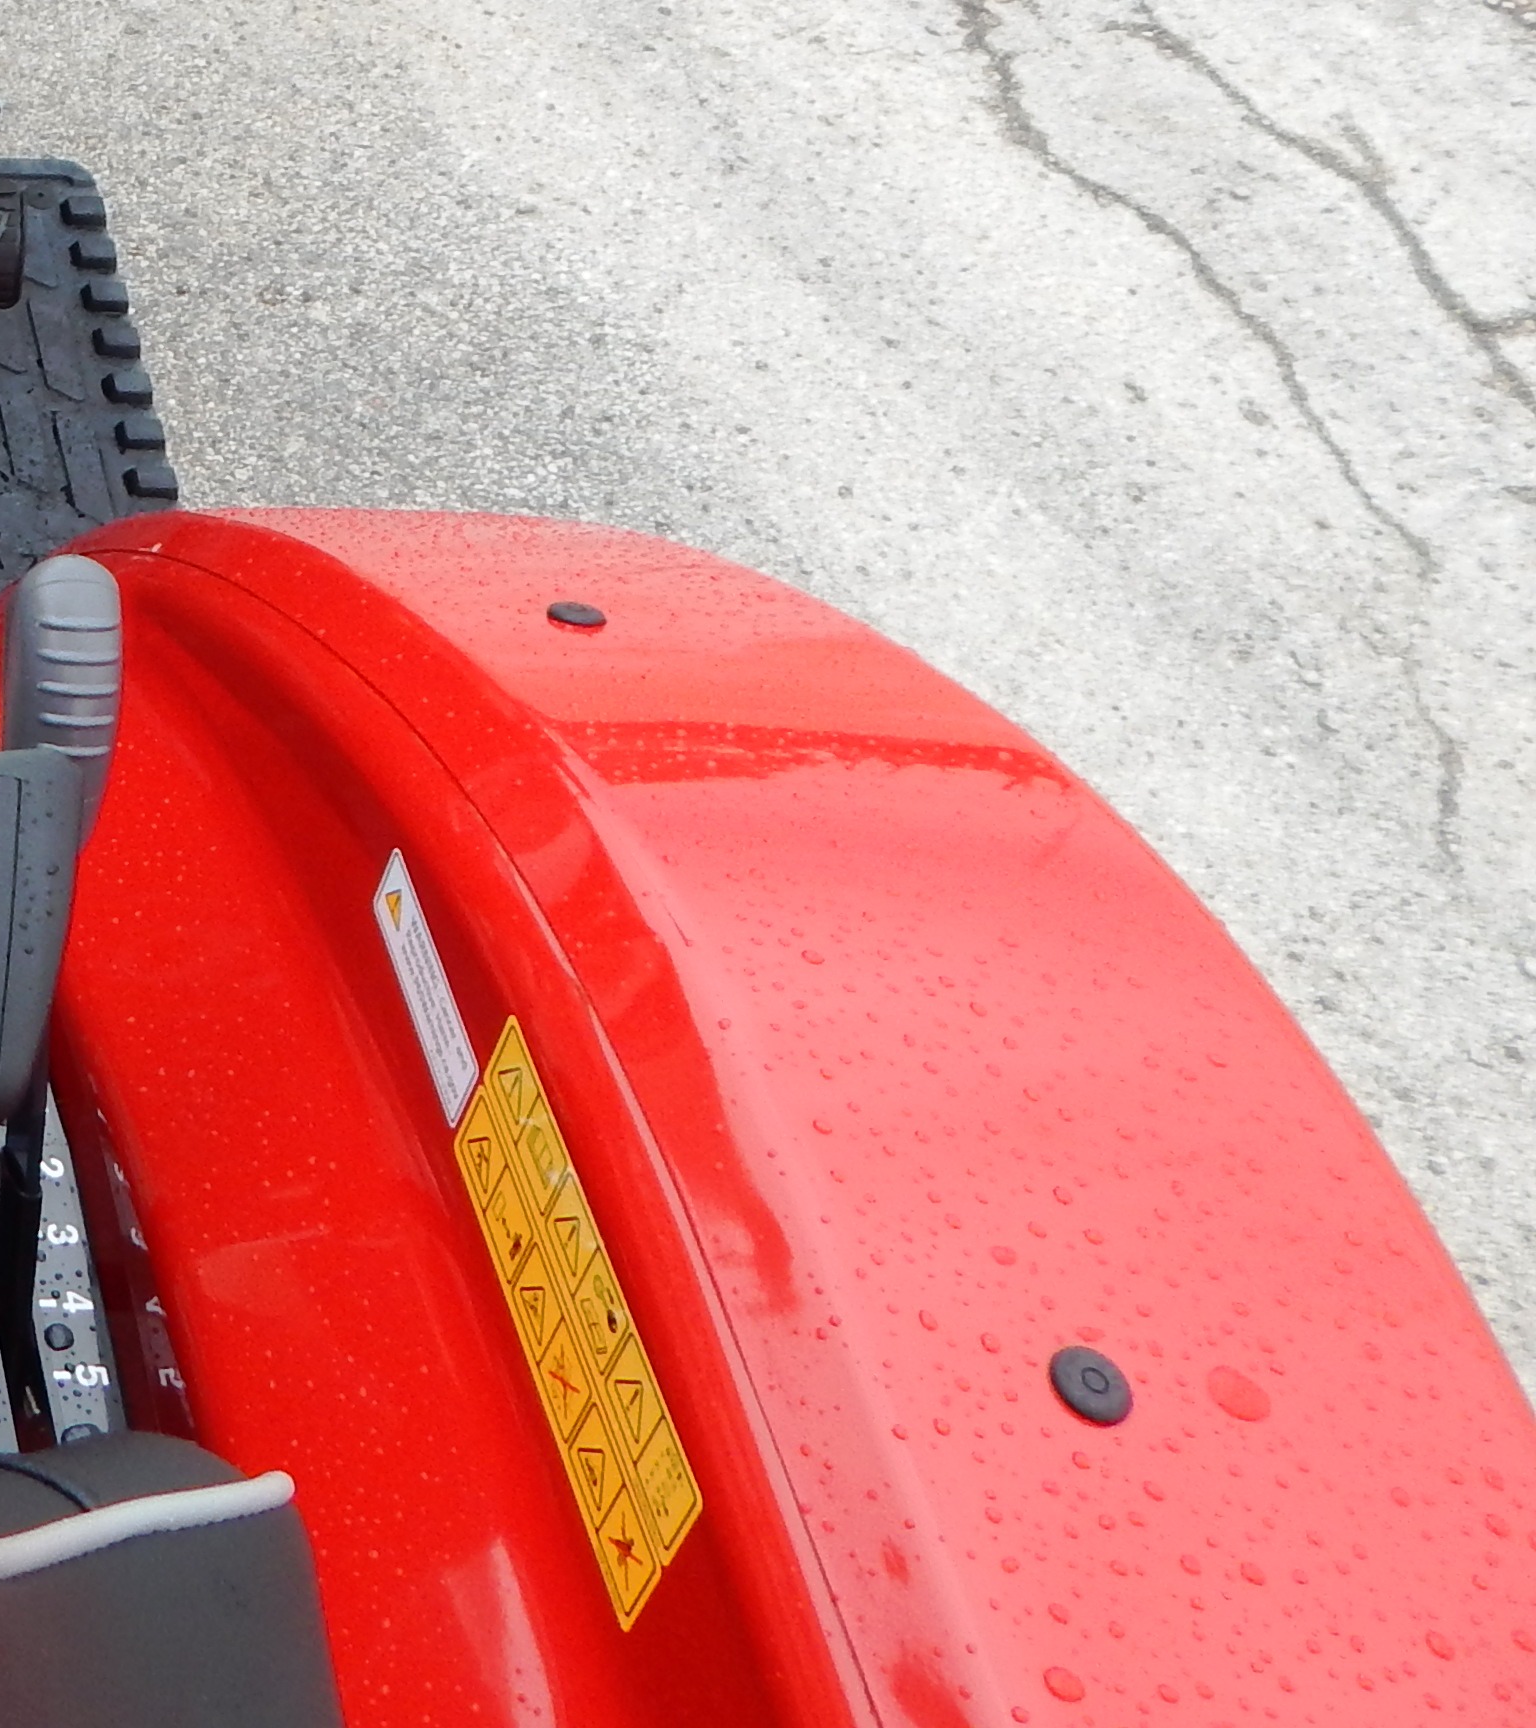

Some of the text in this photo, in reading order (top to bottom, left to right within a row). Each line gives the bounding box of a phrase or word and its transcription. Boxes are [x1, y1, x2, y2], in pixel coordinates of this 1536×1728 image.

[40, 1157, 65, 1178] 2
[46, 1223, 79, 1245] 3
[62, 1290, 95, 1313] 4
[74, 1364, 110, 1387] 5
